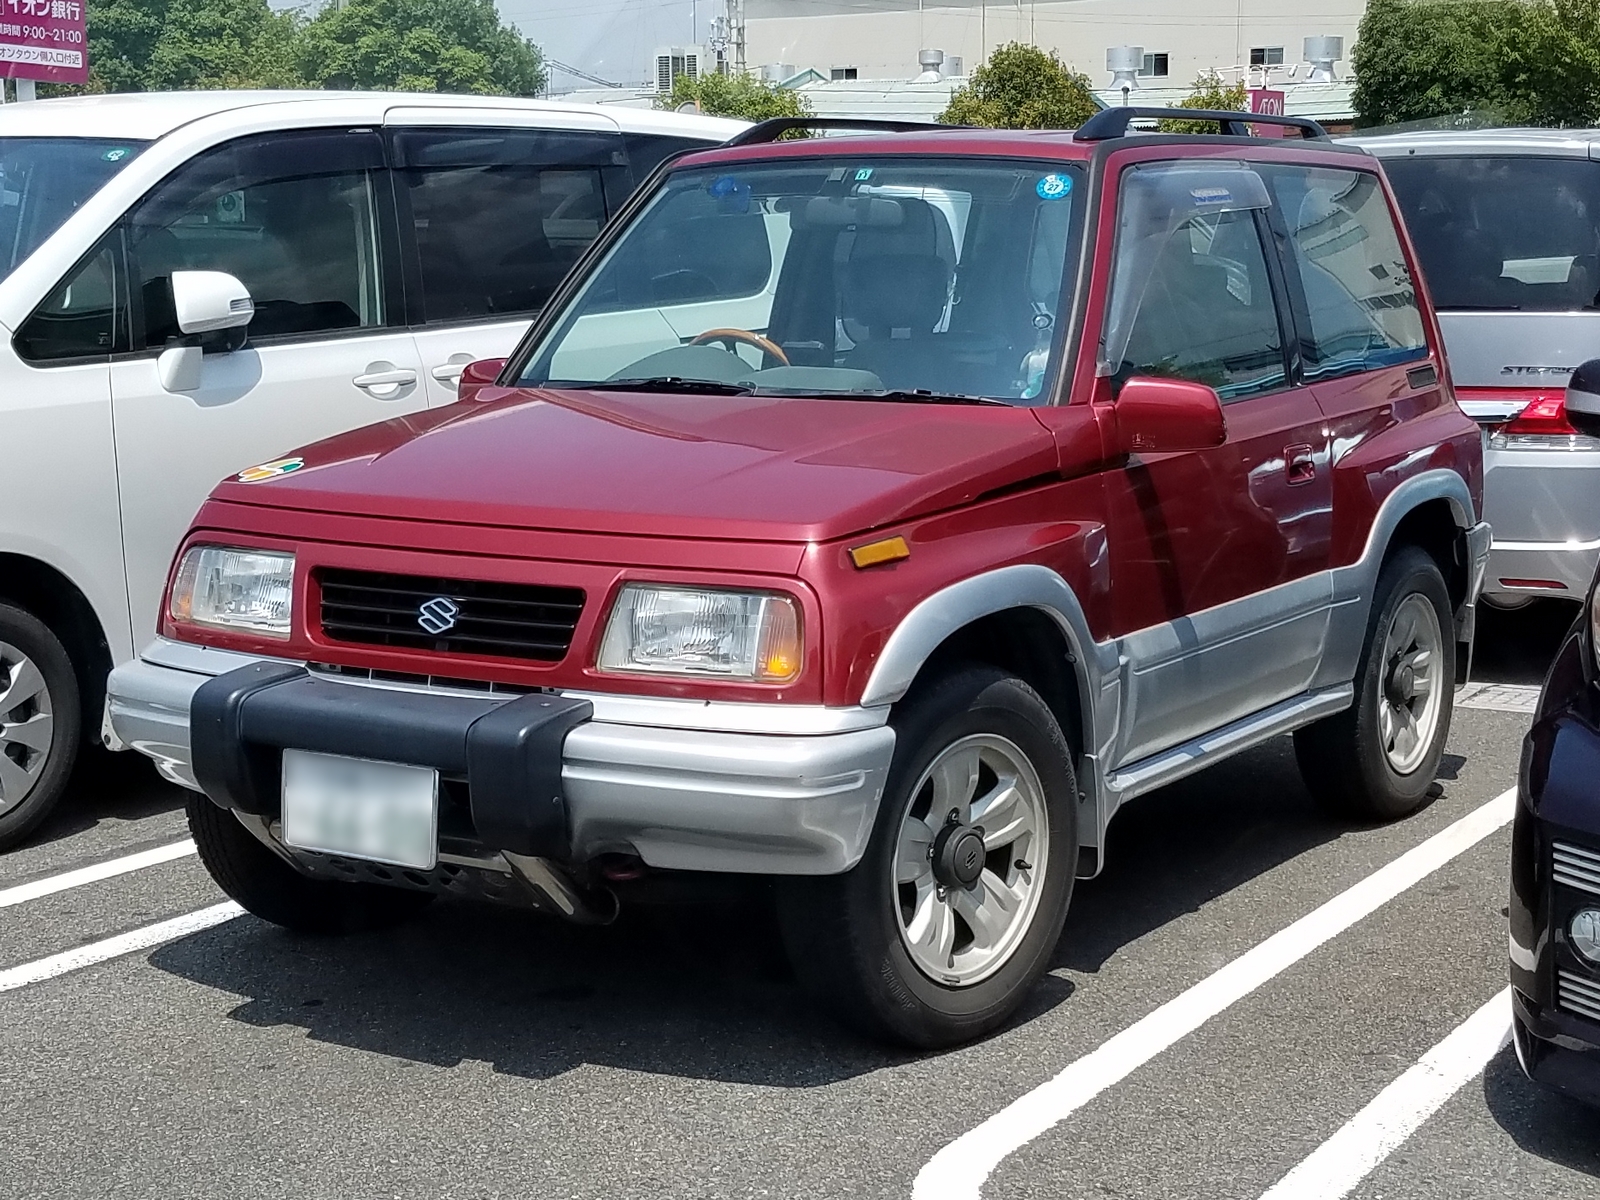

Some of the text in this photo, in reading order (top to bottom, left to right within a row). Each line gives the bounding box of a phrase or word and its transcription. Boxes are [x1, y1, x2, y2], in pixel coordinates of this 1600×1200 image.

[8, 0, 80, 21] イオン銀行
[0, 23, 20, 37] 時間
[1047, 183, 1060, 192] 27
